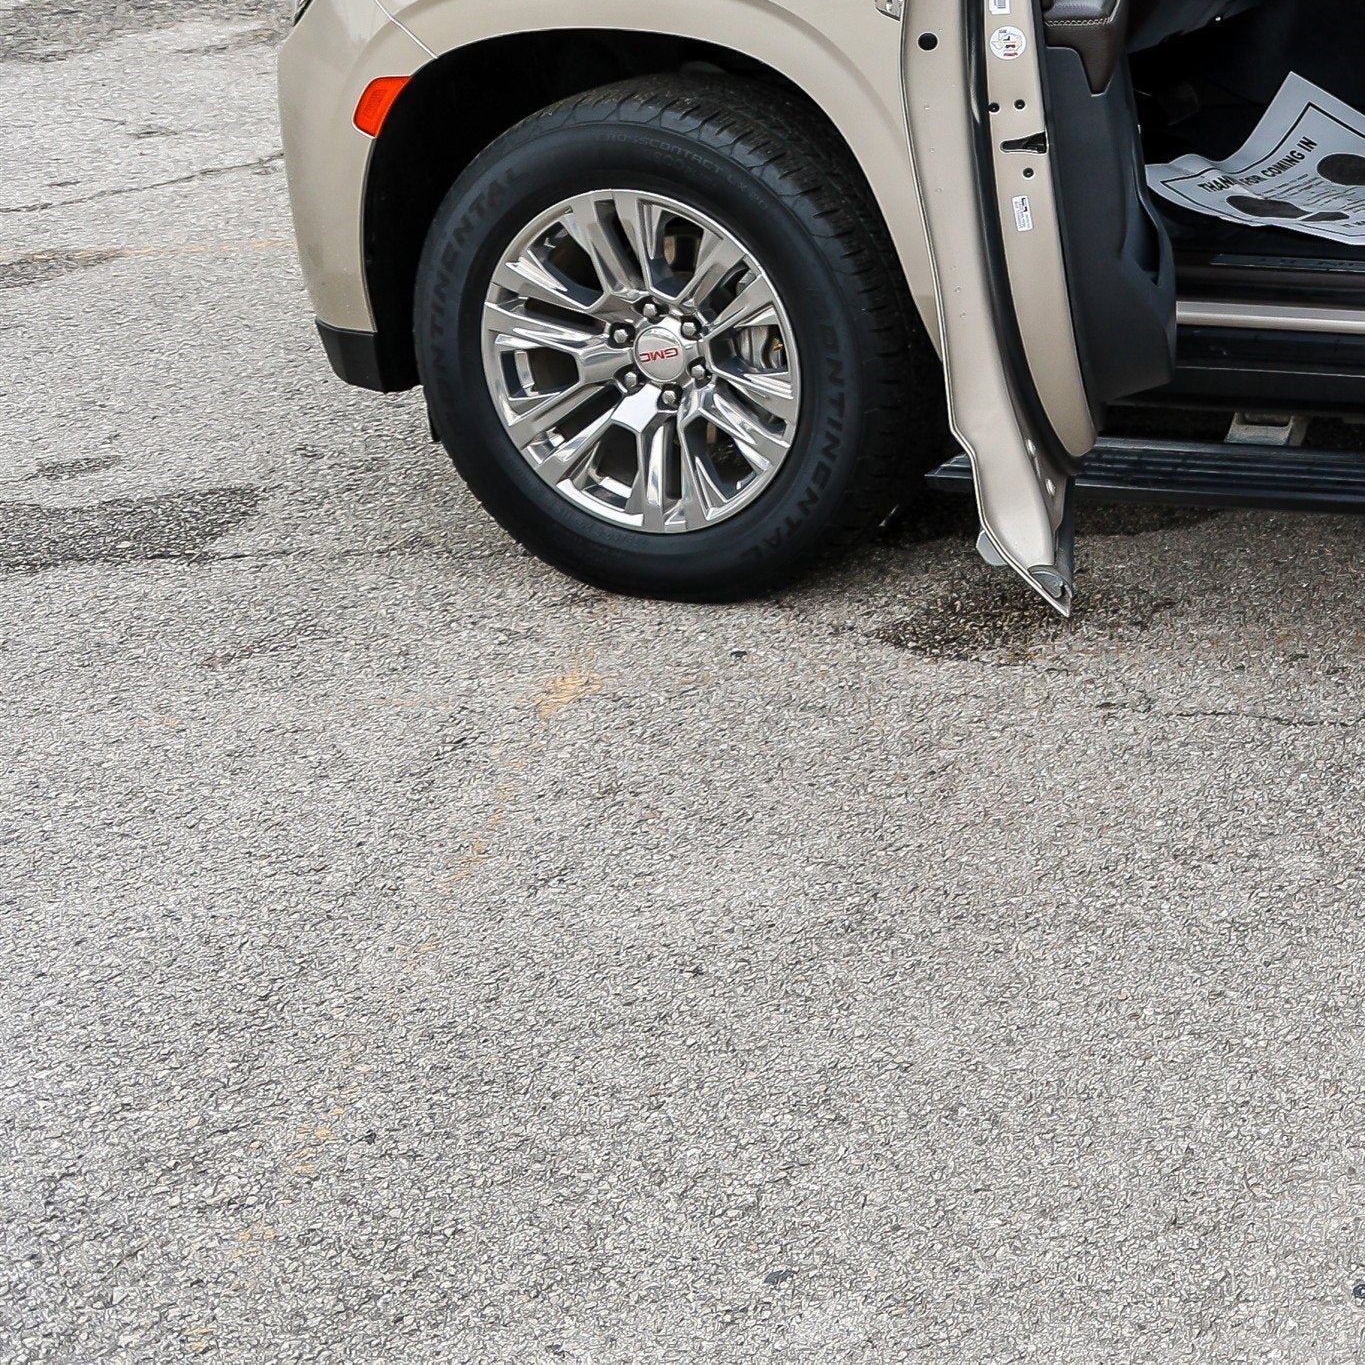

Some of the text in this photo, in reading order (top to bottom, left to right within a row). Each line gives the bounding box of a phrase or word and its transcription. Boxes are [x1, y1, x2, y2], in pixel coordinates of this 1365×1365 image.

[1197, 175, 1239, 192] THAN
[1261, 150, 1306, 178] COMING
[1297, 136, 1318, 153] IN
[640, 347, 678, 363] GMC
